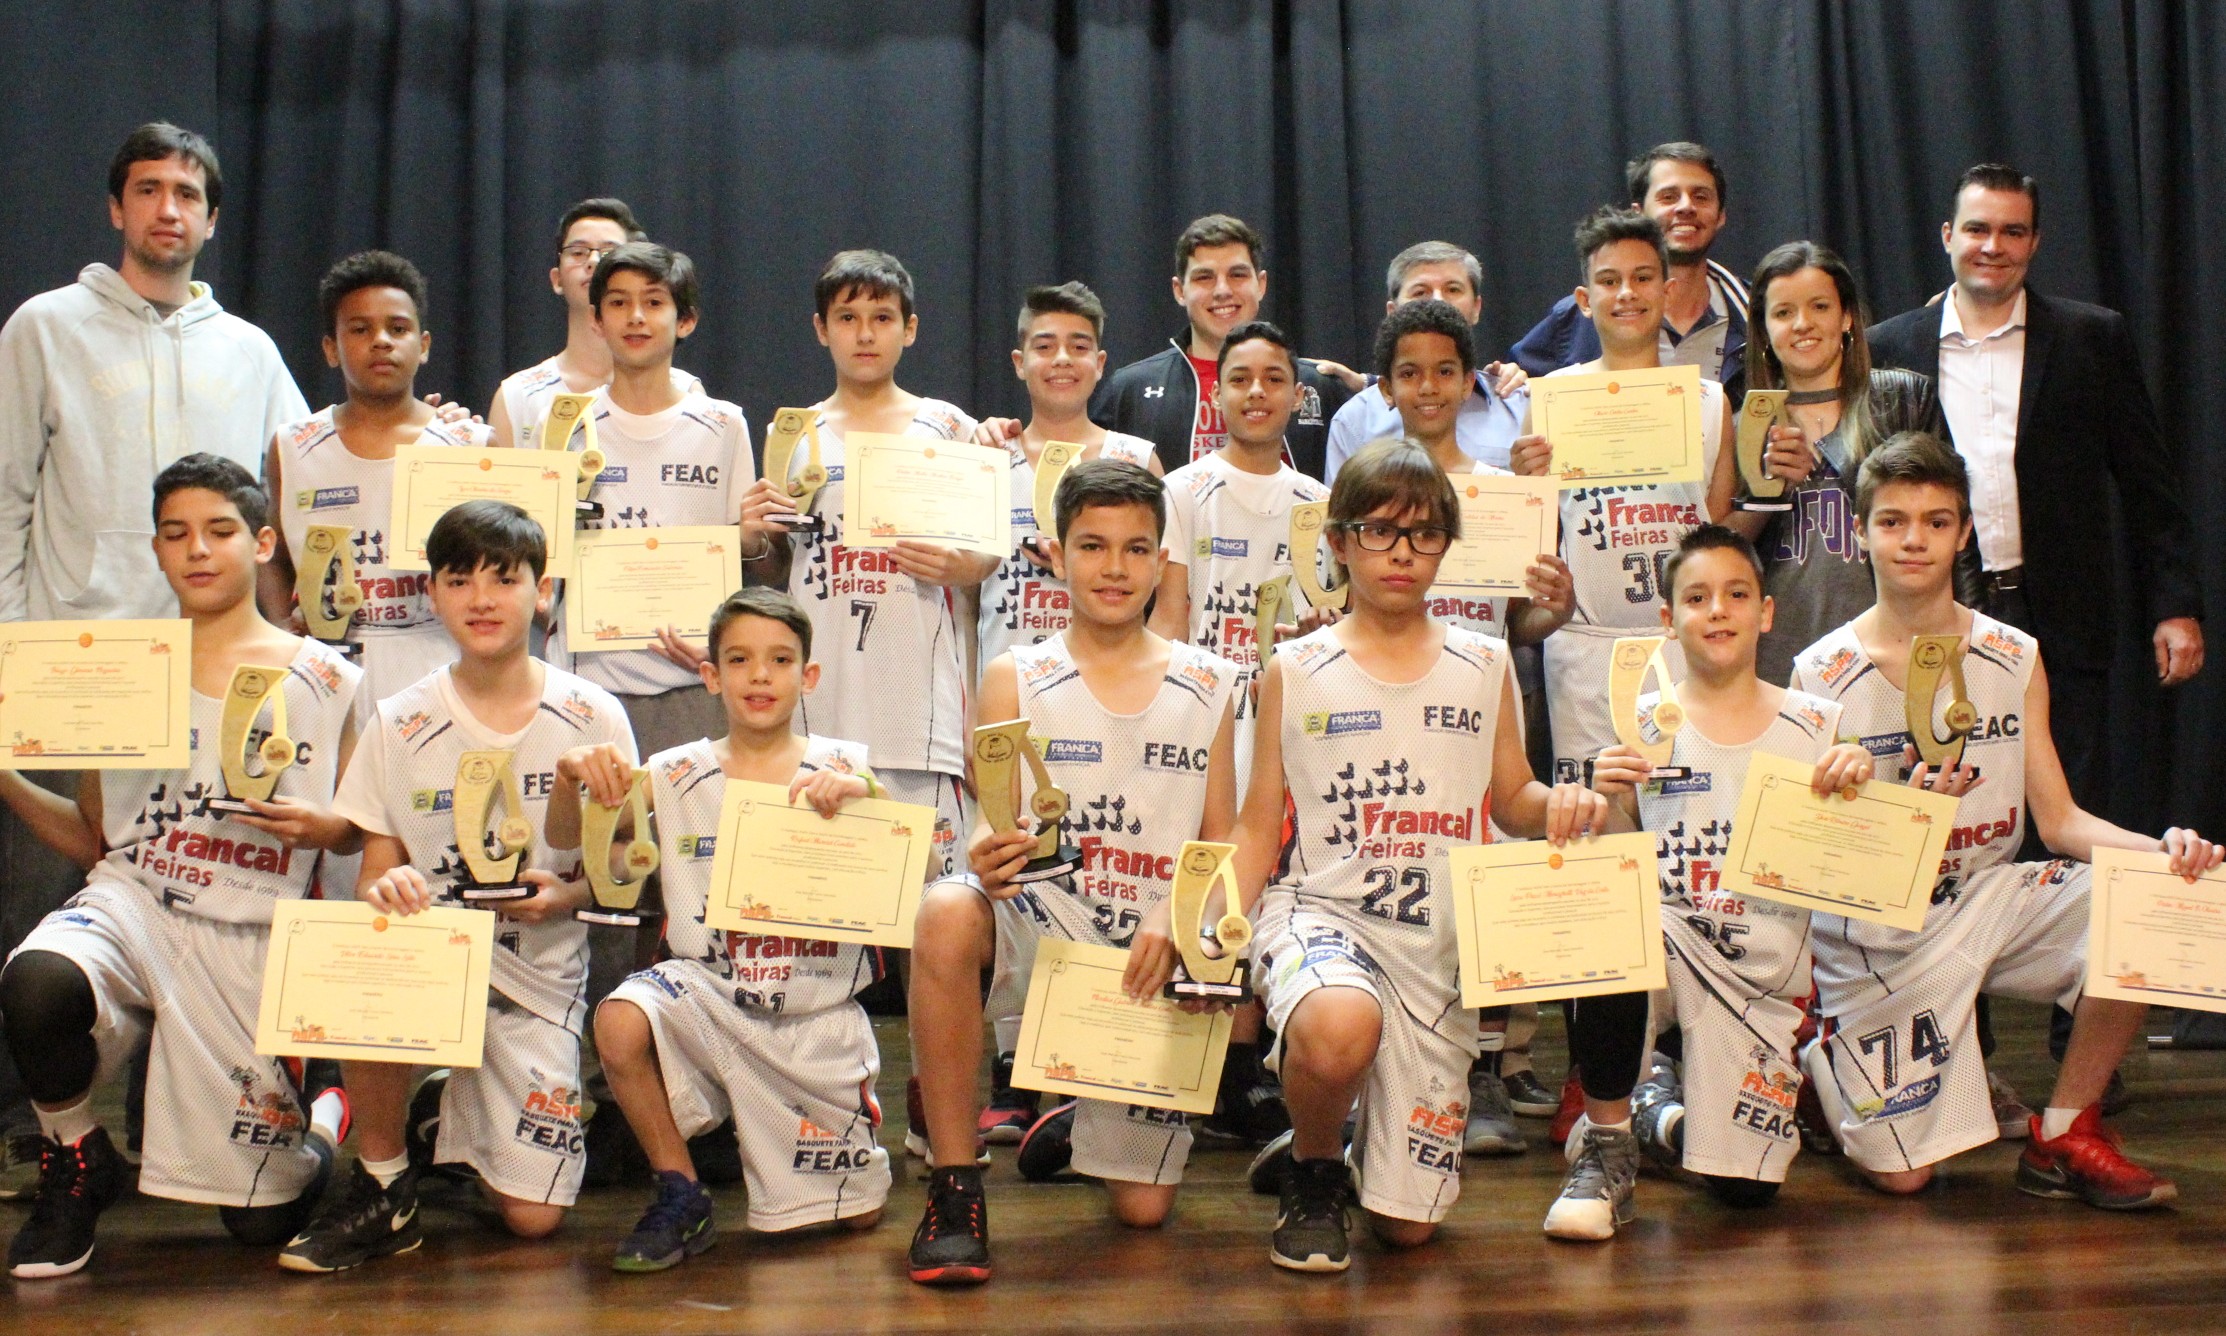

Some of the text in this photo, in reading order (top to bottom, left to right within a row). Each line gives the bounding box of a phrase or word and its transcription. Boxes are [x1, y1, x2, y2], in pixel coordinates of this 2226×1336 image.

[661, 464, 719, 485] FEAC
[1611, 528, 1668, 549] Feiras
[832, 546, 899, 574] Fran
[833, 574, 886, 596] Feiras
[356, 603, 407, 622] eiras
[851, 600, 877, 651] 7
[1023, 612, 1072, 630] Feira
[1332, 713, 1377, 725] FRANCA
[1424, 706, 1482, 733] FEAC
[1968, 714, 2019, 741] EAC
[1051, 743, 1099, 753] FRANCA
[1144, 742, 1208, 772] FEAC
[524, 772, 554, 796] FE
[1363, 803, 1474, 842] Francal
[1950, 807, 2017, 850] ncal
[150, 827, 293, 876] rancal
[1080, 836, 1175, 881] Franc
[1359, 838, 1426, 860] Feiras
[141, 850, 214, 888] Feiras
[1084, 875, 1138, 902] Feras
[1359, 866, 1430, 927] 22
[735, 961, 792, 983] eiras
[1858, 1009, 1949, 1090] 74
[1128, 1104, 1186, 1126] FEA
[1733, 1100, 1795, 1139] FEAC
[230, 1120, 293, 1147] FEA
[516, 1117, 583, 1154] FEAC
[793, 1148, 871, 1171] FEAC
